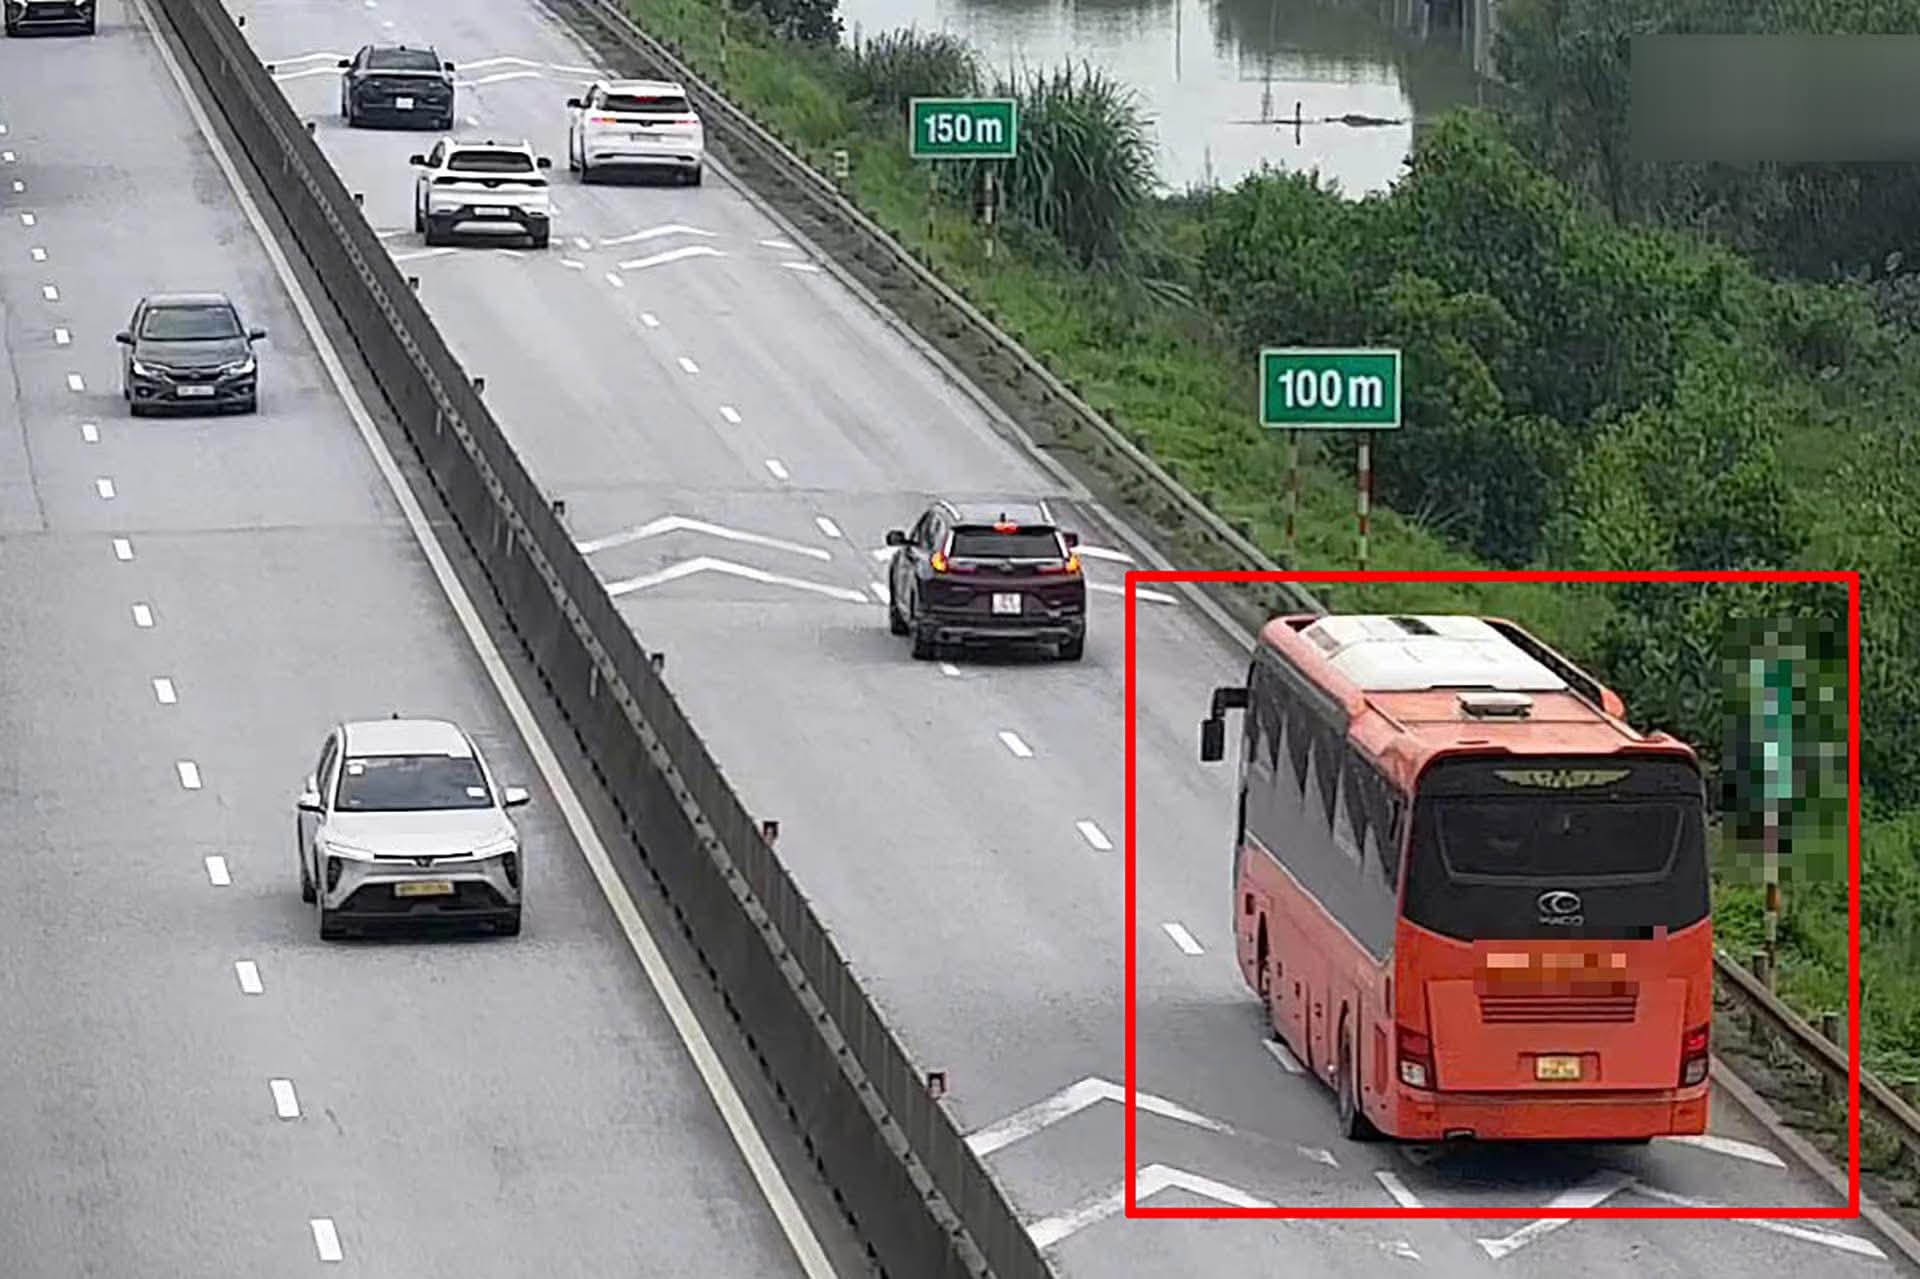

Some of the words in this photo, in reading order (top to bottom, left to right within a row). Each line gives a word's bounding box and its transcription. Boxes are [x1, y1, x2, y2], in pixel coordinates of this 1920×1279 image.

[924, 113, 972, 143] 150
[976, 117, 1003, 143] m
[1277, 369, 1342, 408] 100
[1348, 375, 1383, 408] m
